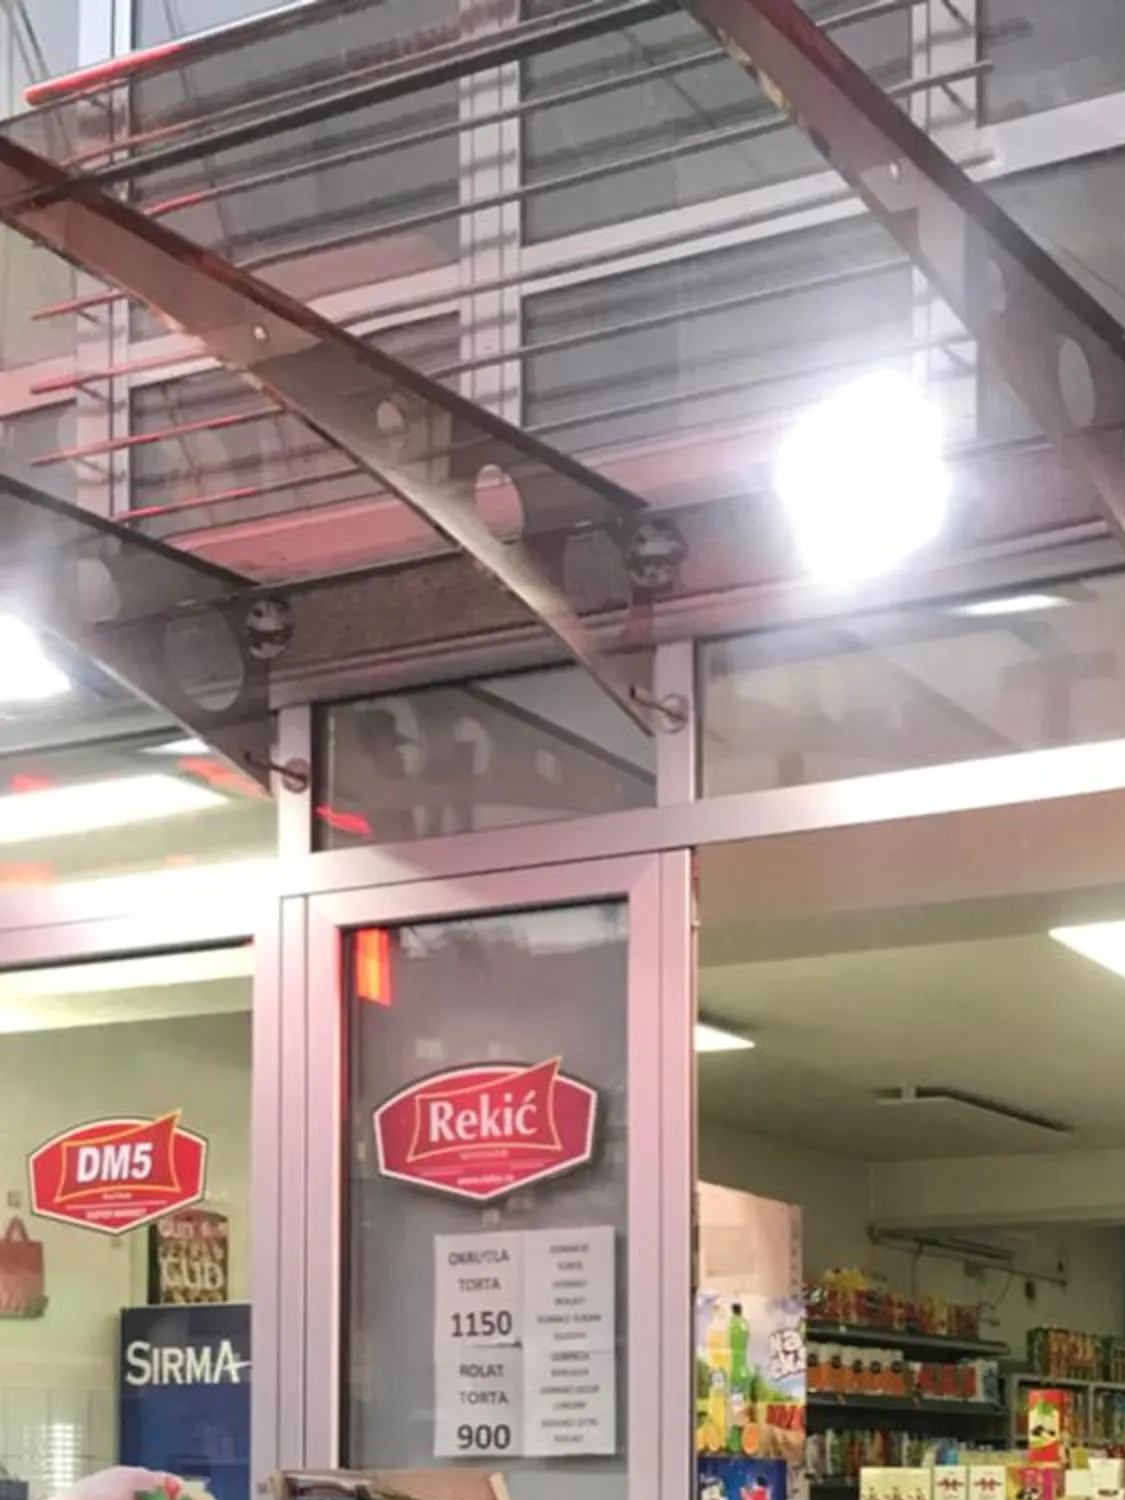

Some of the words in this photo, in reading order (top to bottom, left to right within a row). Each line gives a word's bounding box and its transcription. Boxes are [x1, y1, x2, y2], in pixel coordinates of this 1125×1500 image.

[429, 1089, 538, 1143] Rekić
[77, 1141, 153, 1183] DM5
[451, 1310, 513, 1338] 1150
[125, 1339, 250, 1385] SIRMA
[459, 1363, 505, 1378] ROLAT
[459, 1390, 510, 1405] TORTA
[456, 1423, 512, 1450] 900
